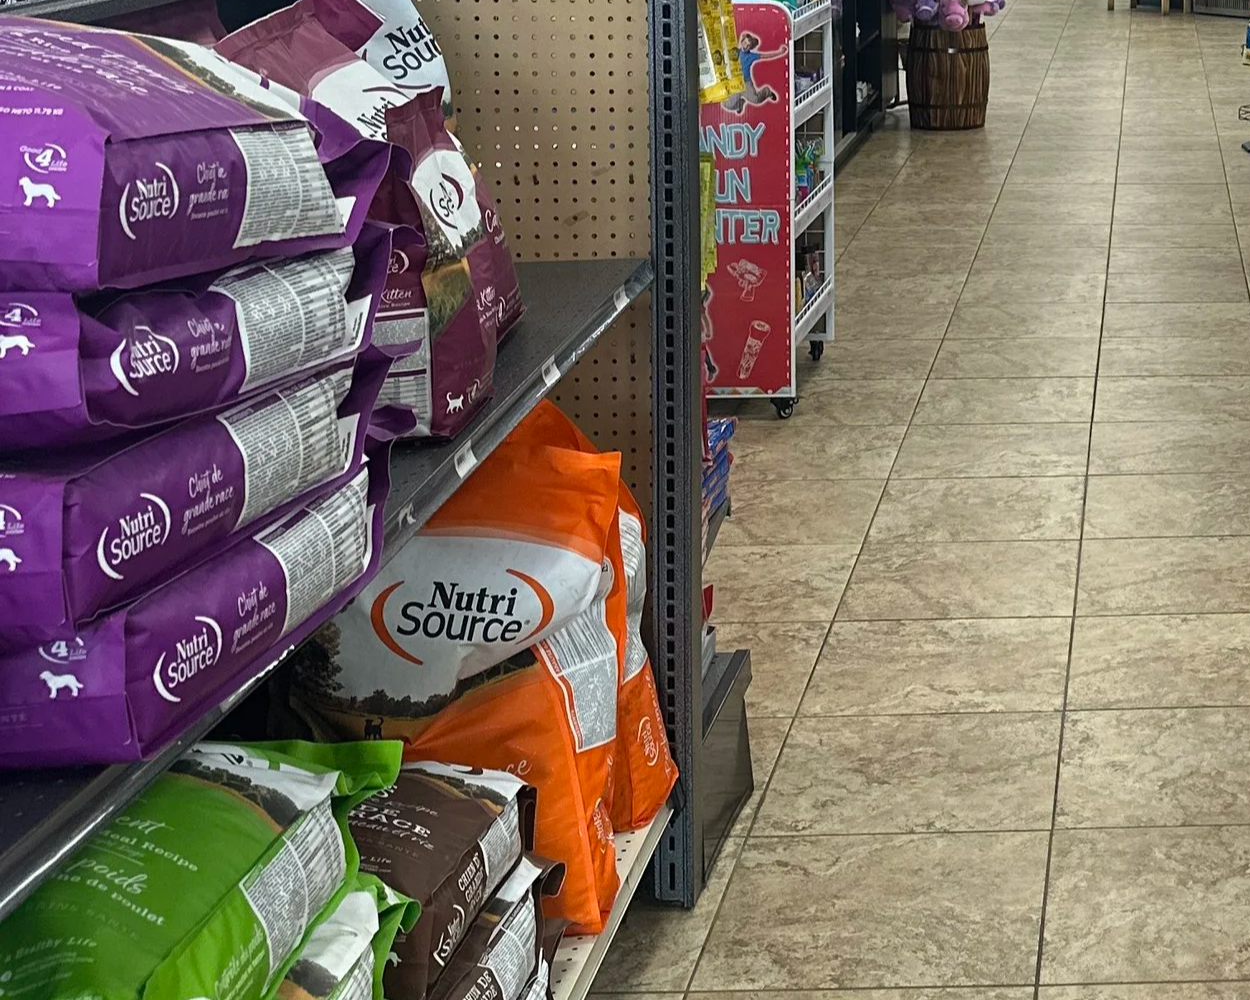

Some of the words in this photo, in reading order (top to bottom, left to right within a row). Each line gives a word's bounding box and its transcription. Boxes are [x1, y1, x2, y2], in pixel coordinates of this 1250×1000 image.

[119, 505, 155, 540] Nutri
[111, 525, 161, 566] Source
[430, 580, 517, 617] Nutri
[396, 602, 525, 644] Source
[176, 626, 209, 663] Nutri
[168, 645, 214, 689] Source
[142, 841, 198, 872] Recipe
[66, 858, 148, 896] poids
[87, 877, 108, 892] de
[111, 892, 166, 927] poulet
[67, 936, 97, 948] Life
